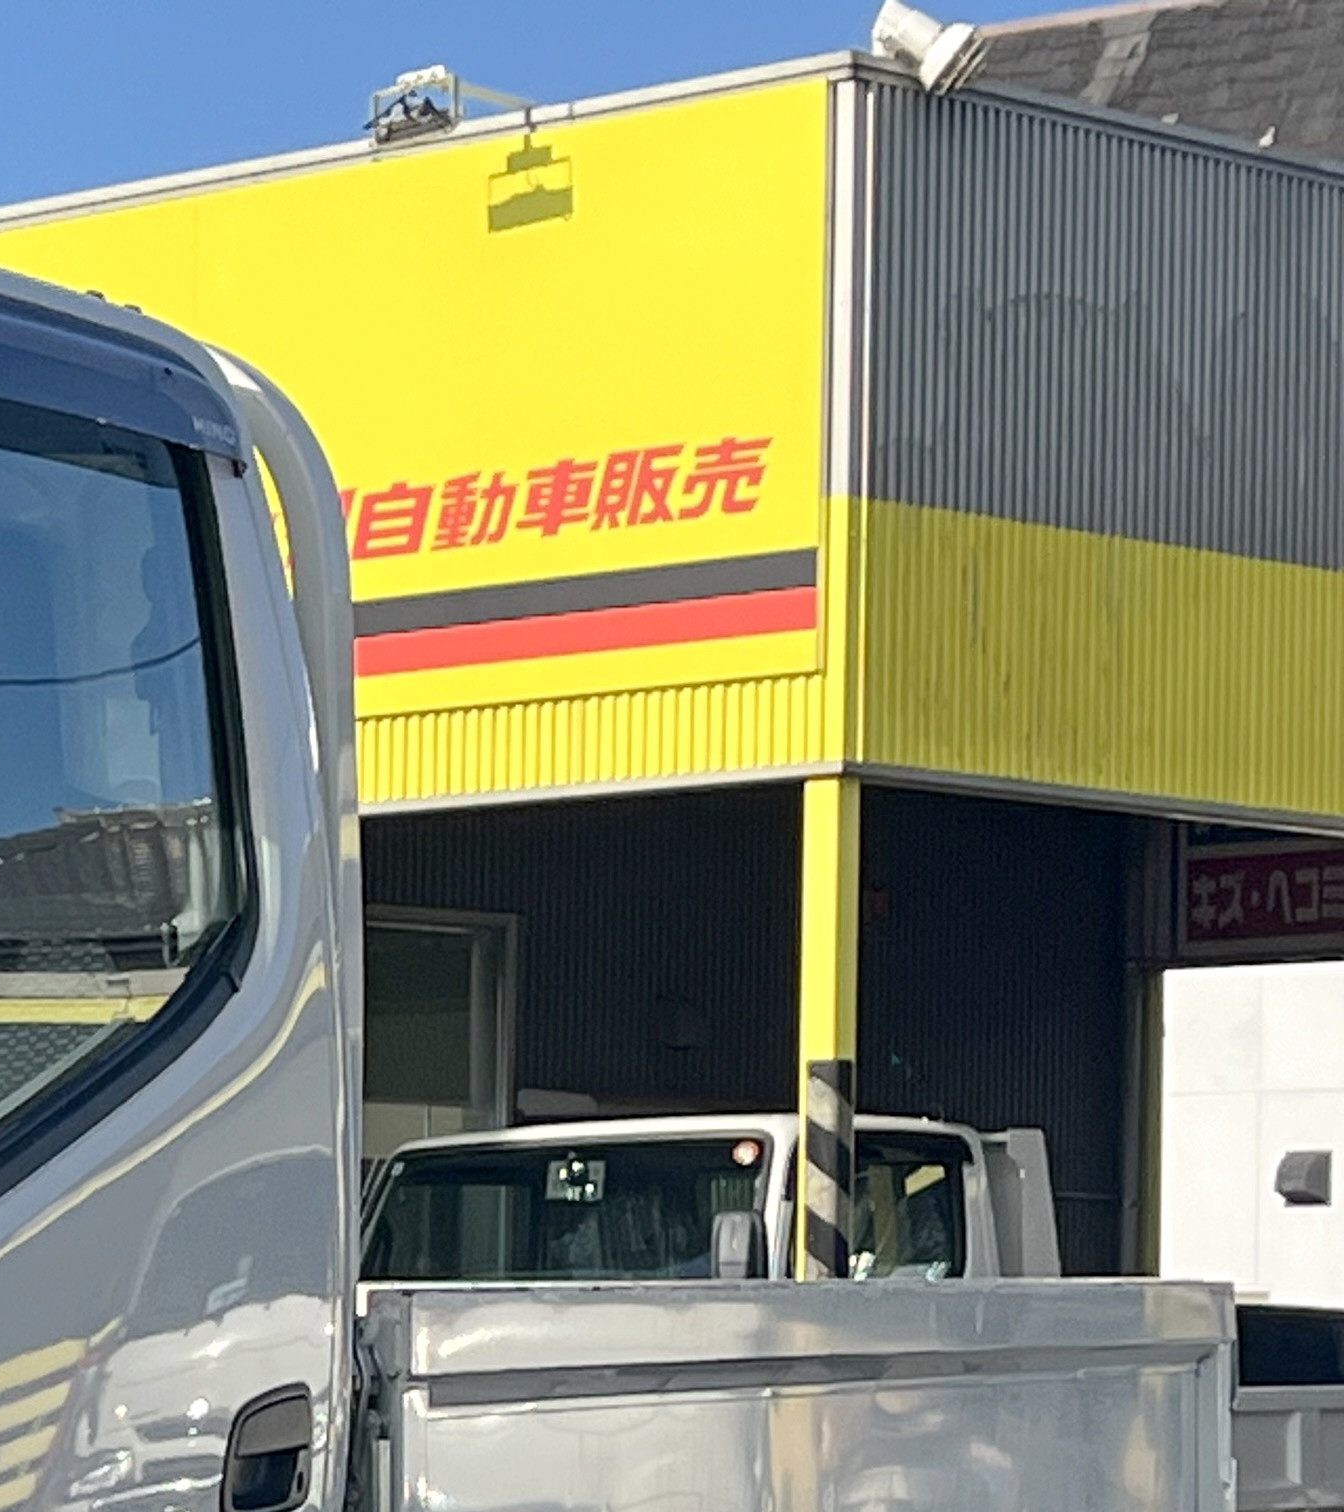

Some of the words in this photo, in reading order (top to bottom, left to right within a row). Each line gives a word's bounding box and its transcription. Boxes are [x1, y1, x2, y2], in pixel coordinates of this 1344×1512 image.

[341, 436, 774, 561] 自動車販売
